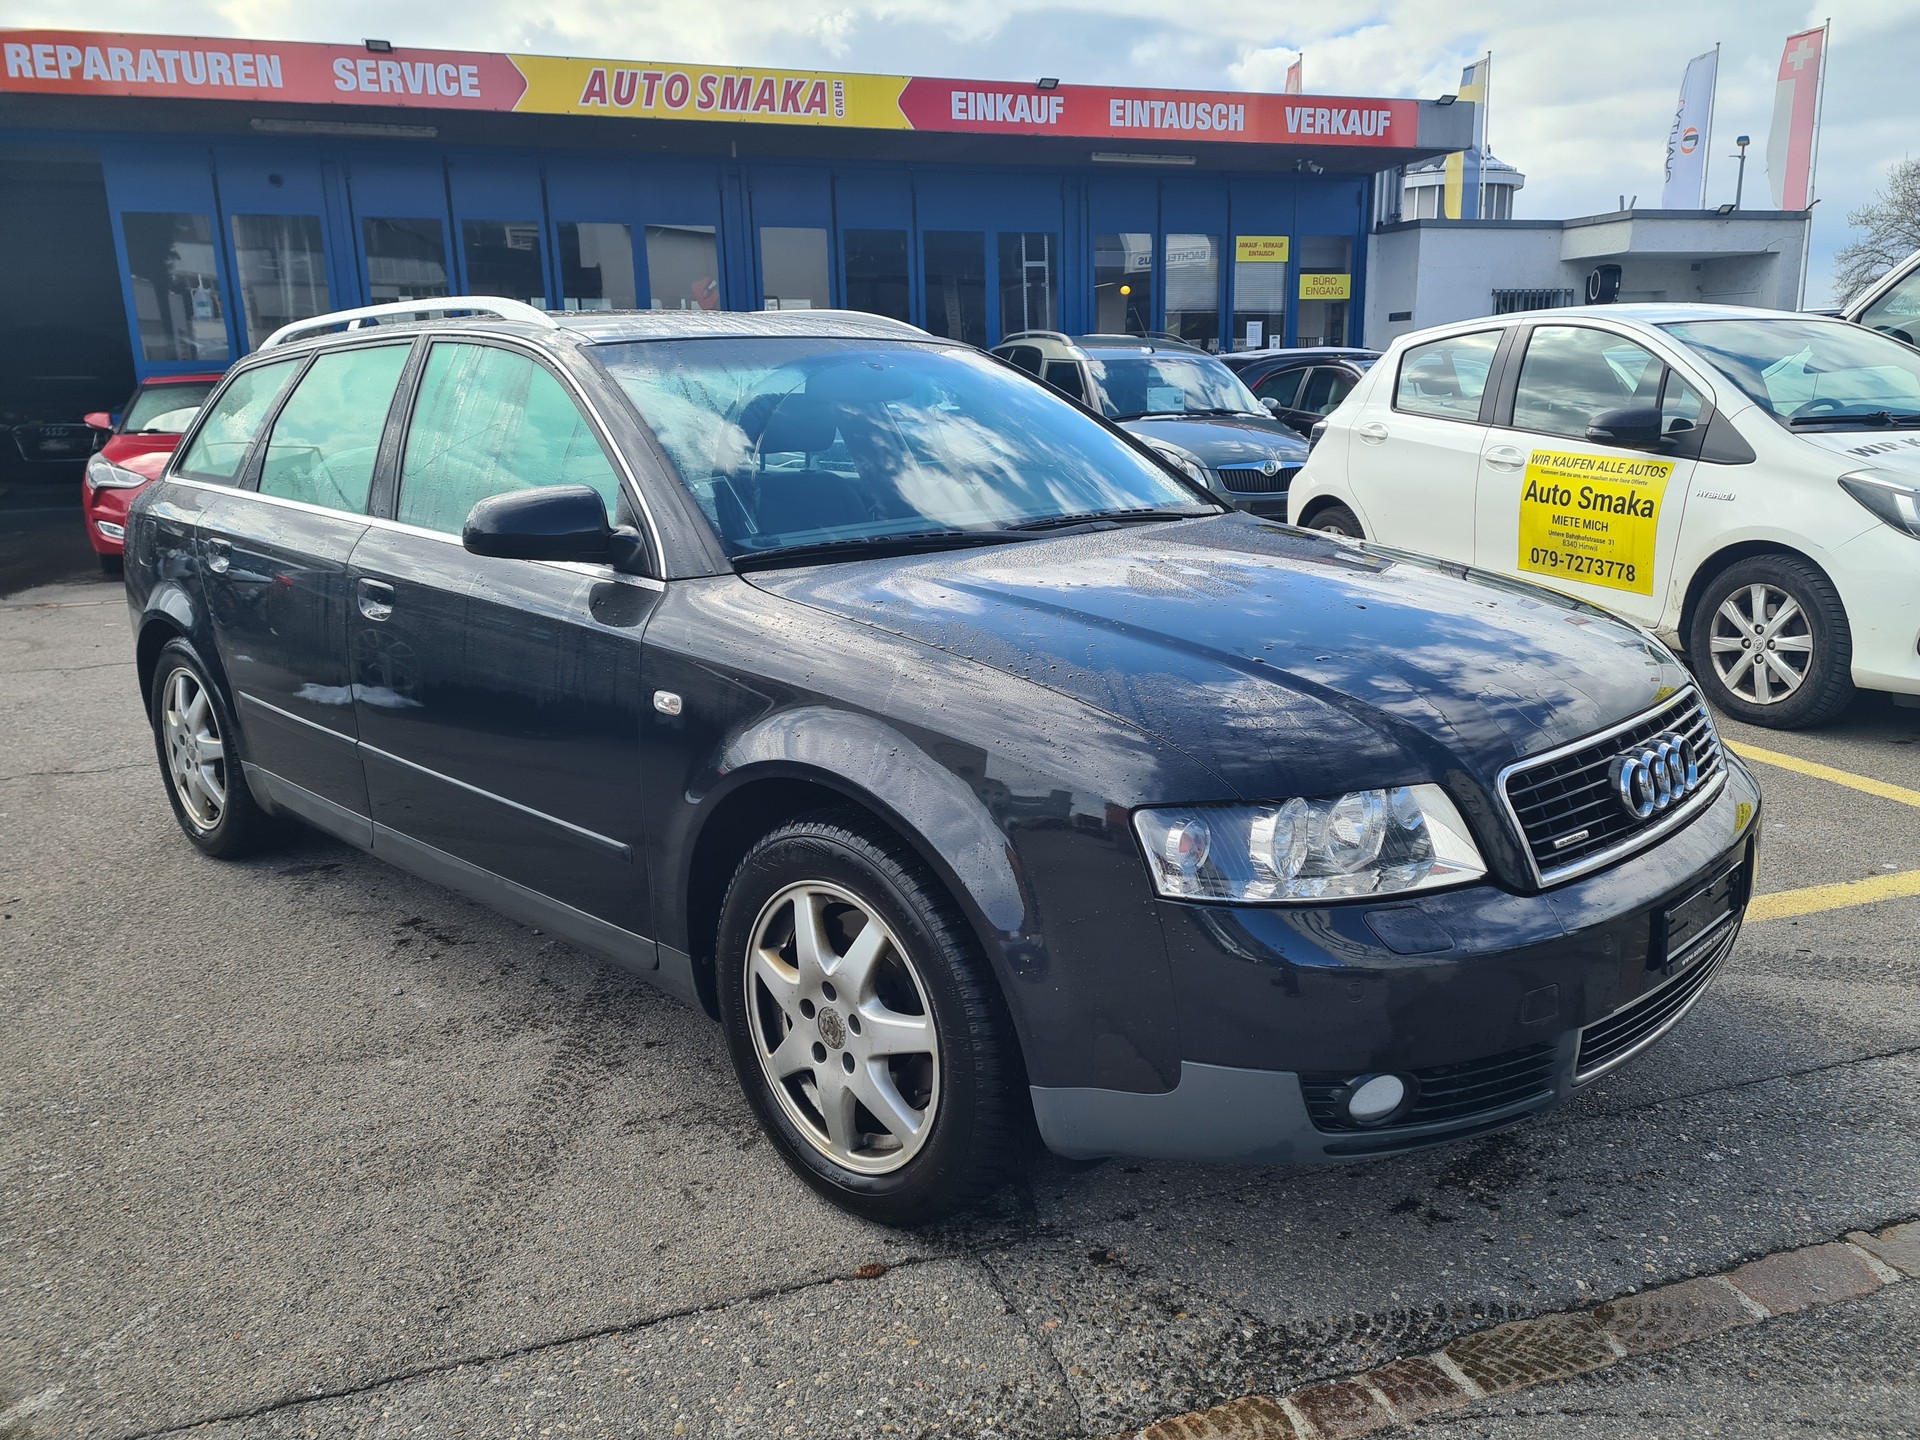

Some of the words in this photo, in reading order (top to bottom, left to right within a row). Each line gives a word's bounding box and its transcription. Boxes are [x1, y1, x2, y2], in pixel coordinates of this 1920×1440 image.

[4, 43, 282, 88] REPARATUREN
[333, 57, 481, 99] SERVICE
[579, 67, 690, 110] AUTO
[695, 73, 829, 117] SMAKA
[834, 80, 844, 118] GMBH
[951, 90, 1064, 125] EINKAUF
[1109, 98, 1245, 133] EINTAUSCH
[1285, 106, 1392, 138] VERKAUF
[1239, 242, 1258, 250] ANKAUF
[1262, 242, 1284, 250] VERKAUF
[1305, 286, 1344, 296] EINGANG
[1312, 275, 1338, 286] BÜRO
[1531, 453, 1550, 467] WIR
[1552, 456, 1596, 471] KAUFEN
[1596, 460, 1625, 474] ALLE
[1626, 464, 1668, 479] AUTOS
[1524, 480, 1572, 507] Auto
[1577, 486, 1655, 518] Smaka
[1696, 490, 1728, 501] HYBRID
[1548, 529, 1565, 539] Untere
[1552, 514, 1581, 529] MIETE
[1583, 518, 1609, 533] MICH
[1562, 540, 1577, 549] 8340
[1530, 548, 1636, 582] 079-7273778
